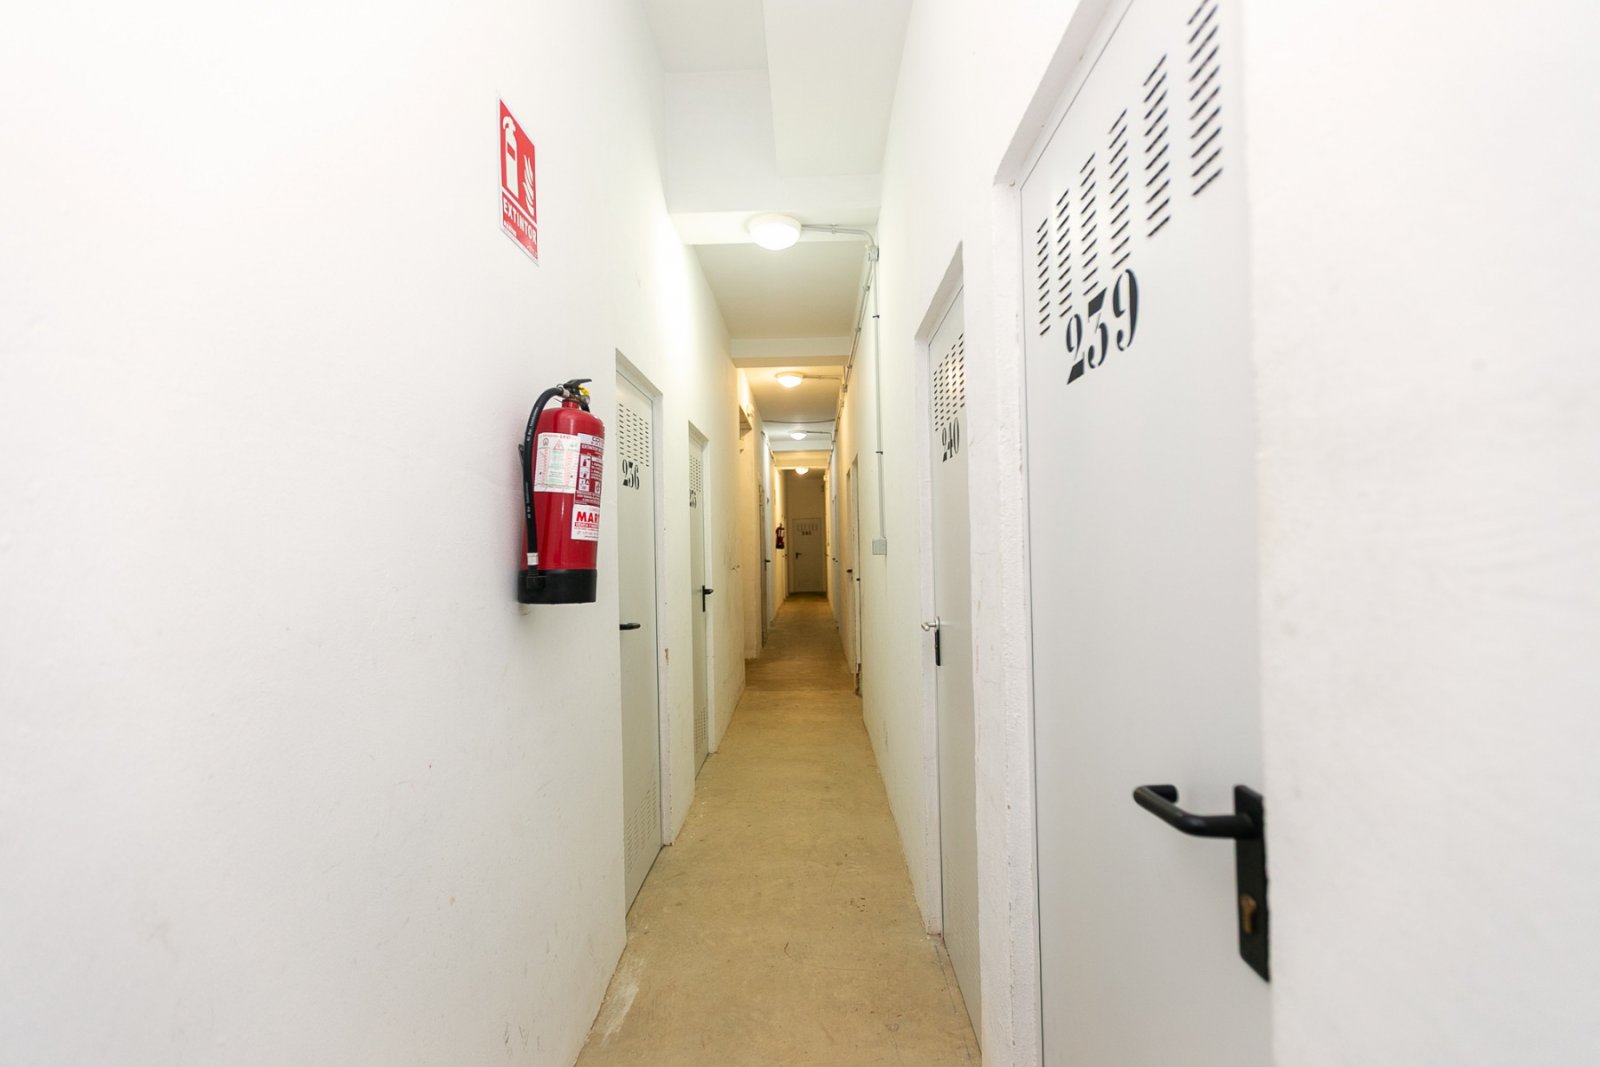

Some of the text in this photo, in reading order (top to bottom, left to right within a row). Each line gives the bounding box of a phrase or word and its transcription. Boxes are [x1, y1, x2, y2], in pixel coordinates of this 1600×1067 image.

[503, 197, 537, 245] EXTINTOR
[1066, 269, 1139, 385] 239
[942, 418, 960, 462] 240
[622, 459, 639, 490] 236
